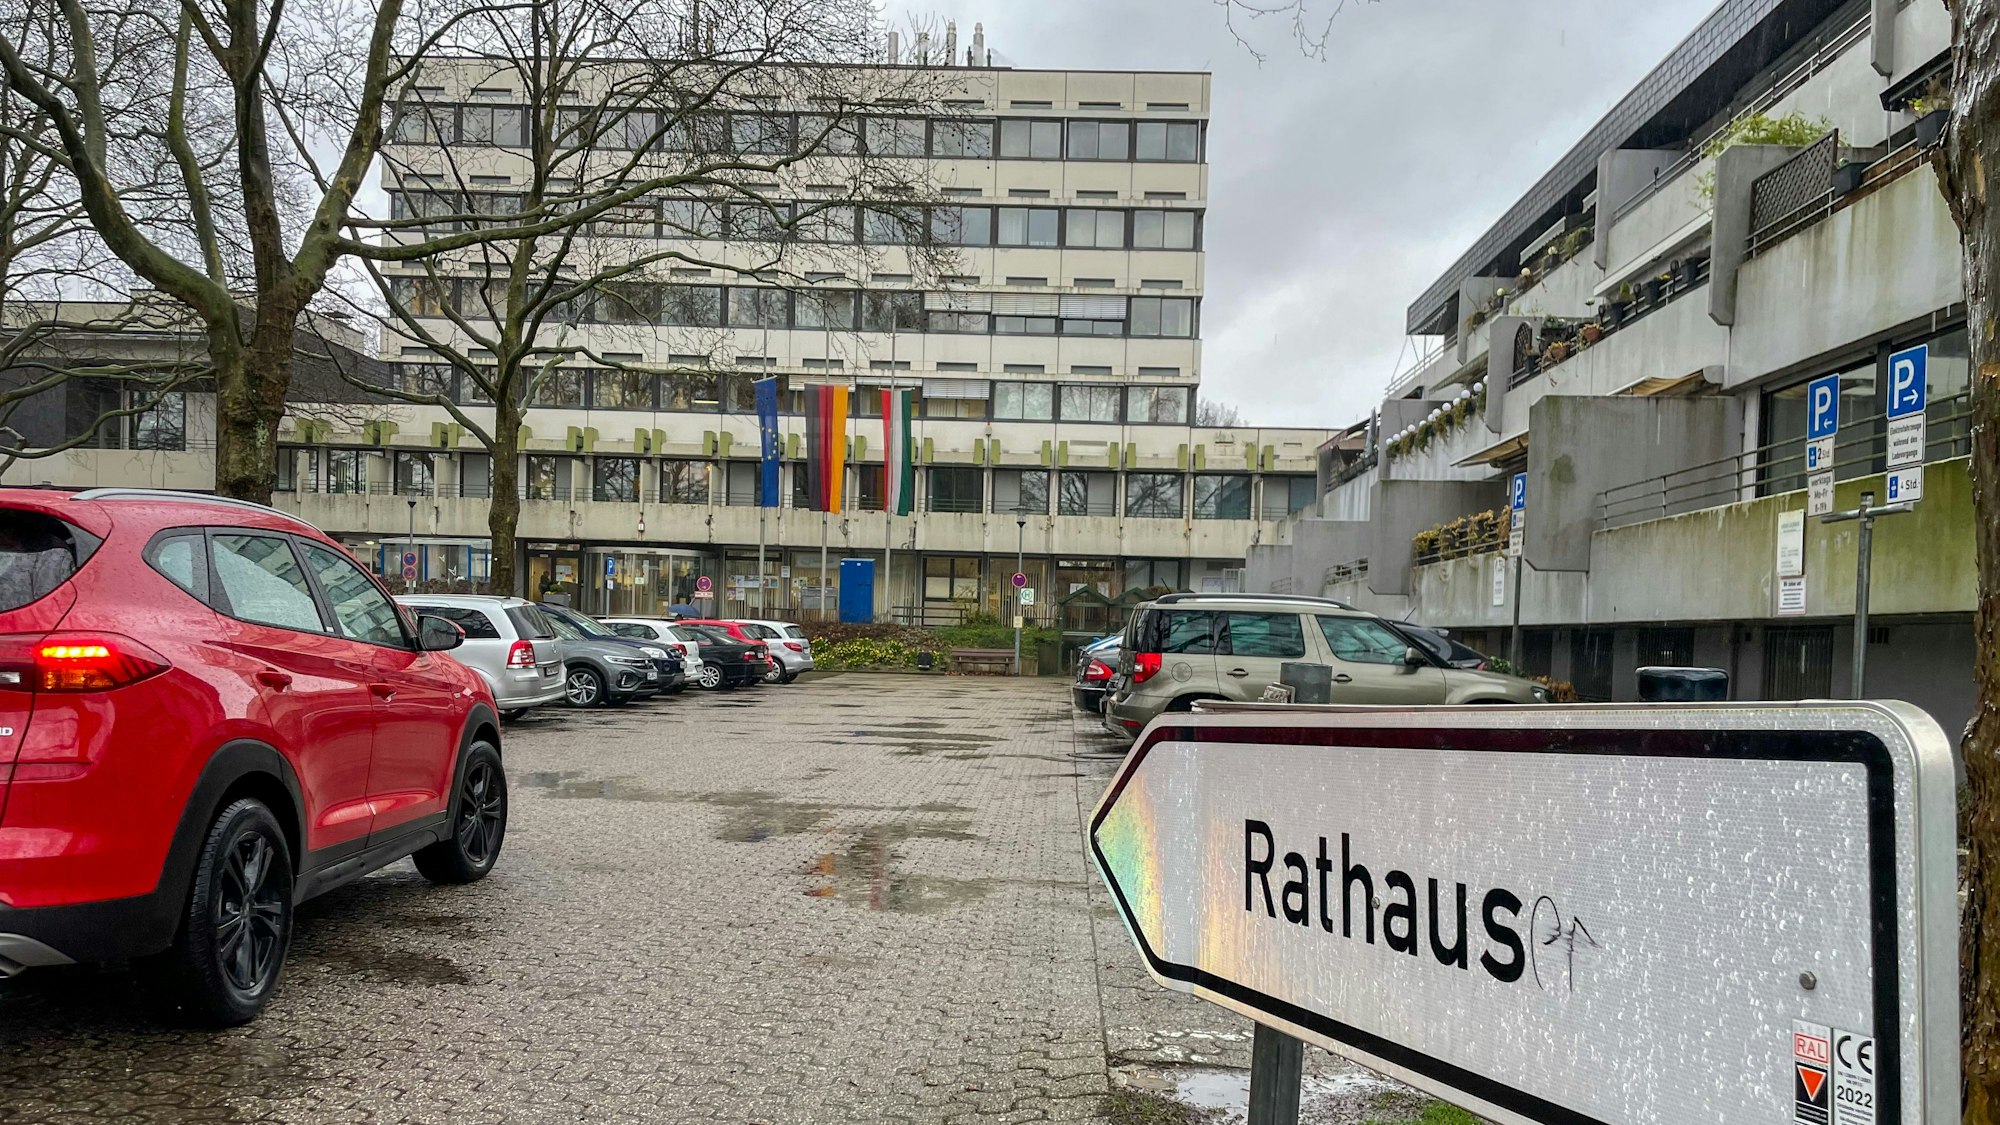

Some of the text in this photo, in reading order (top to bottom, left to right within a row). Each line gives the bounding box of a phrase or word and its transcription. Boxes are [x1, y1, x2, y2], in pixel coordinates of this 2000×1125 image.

[1893, 358, 1915, 410] P
[1814, 385, 1832, 432] P
[1514, 478, 1523, 507] P
[1245, 819, 1526, 983] Rathaus
[1797, 1037, 1825, 1059] RAL
[1836, 1035, 1873, 1076] CE
[1836, 1084, 1873, 1109] 2022
